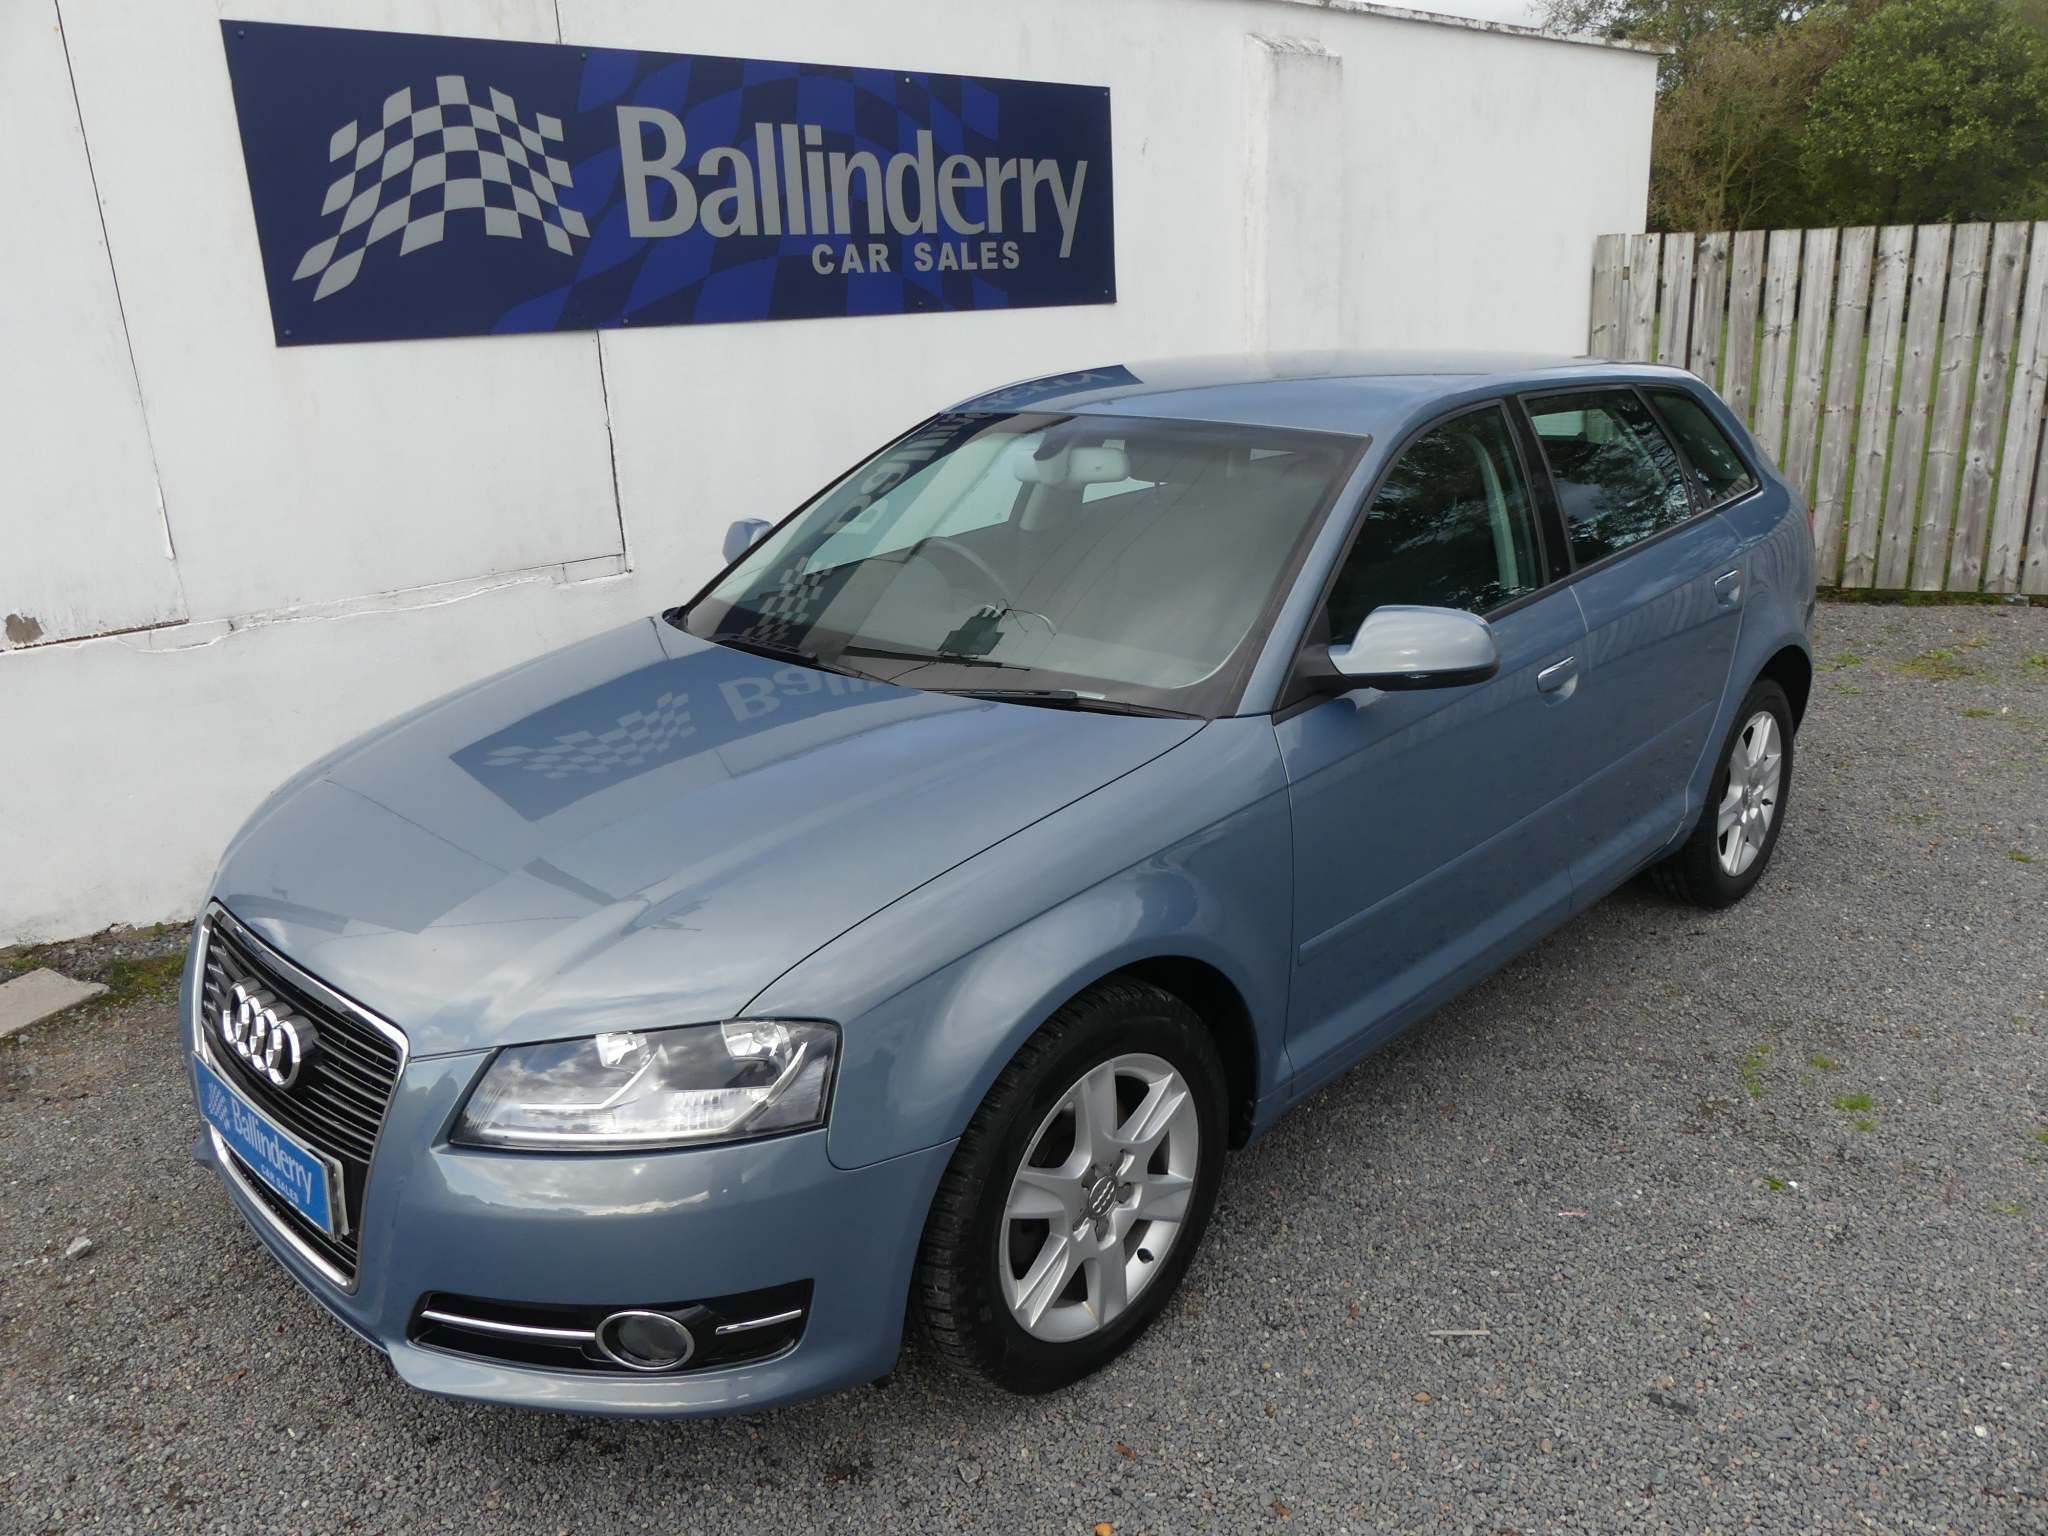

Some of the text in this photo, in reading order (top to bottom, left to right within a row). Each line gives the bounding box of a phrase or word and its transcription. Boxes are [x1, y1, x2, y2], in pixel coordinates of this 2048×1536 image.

[615, 104, 1088, 259] Ballinderry
[811, 241, 1021, 275] CAR SALES
[231, 1097, 312, 1204] Ballinderry
